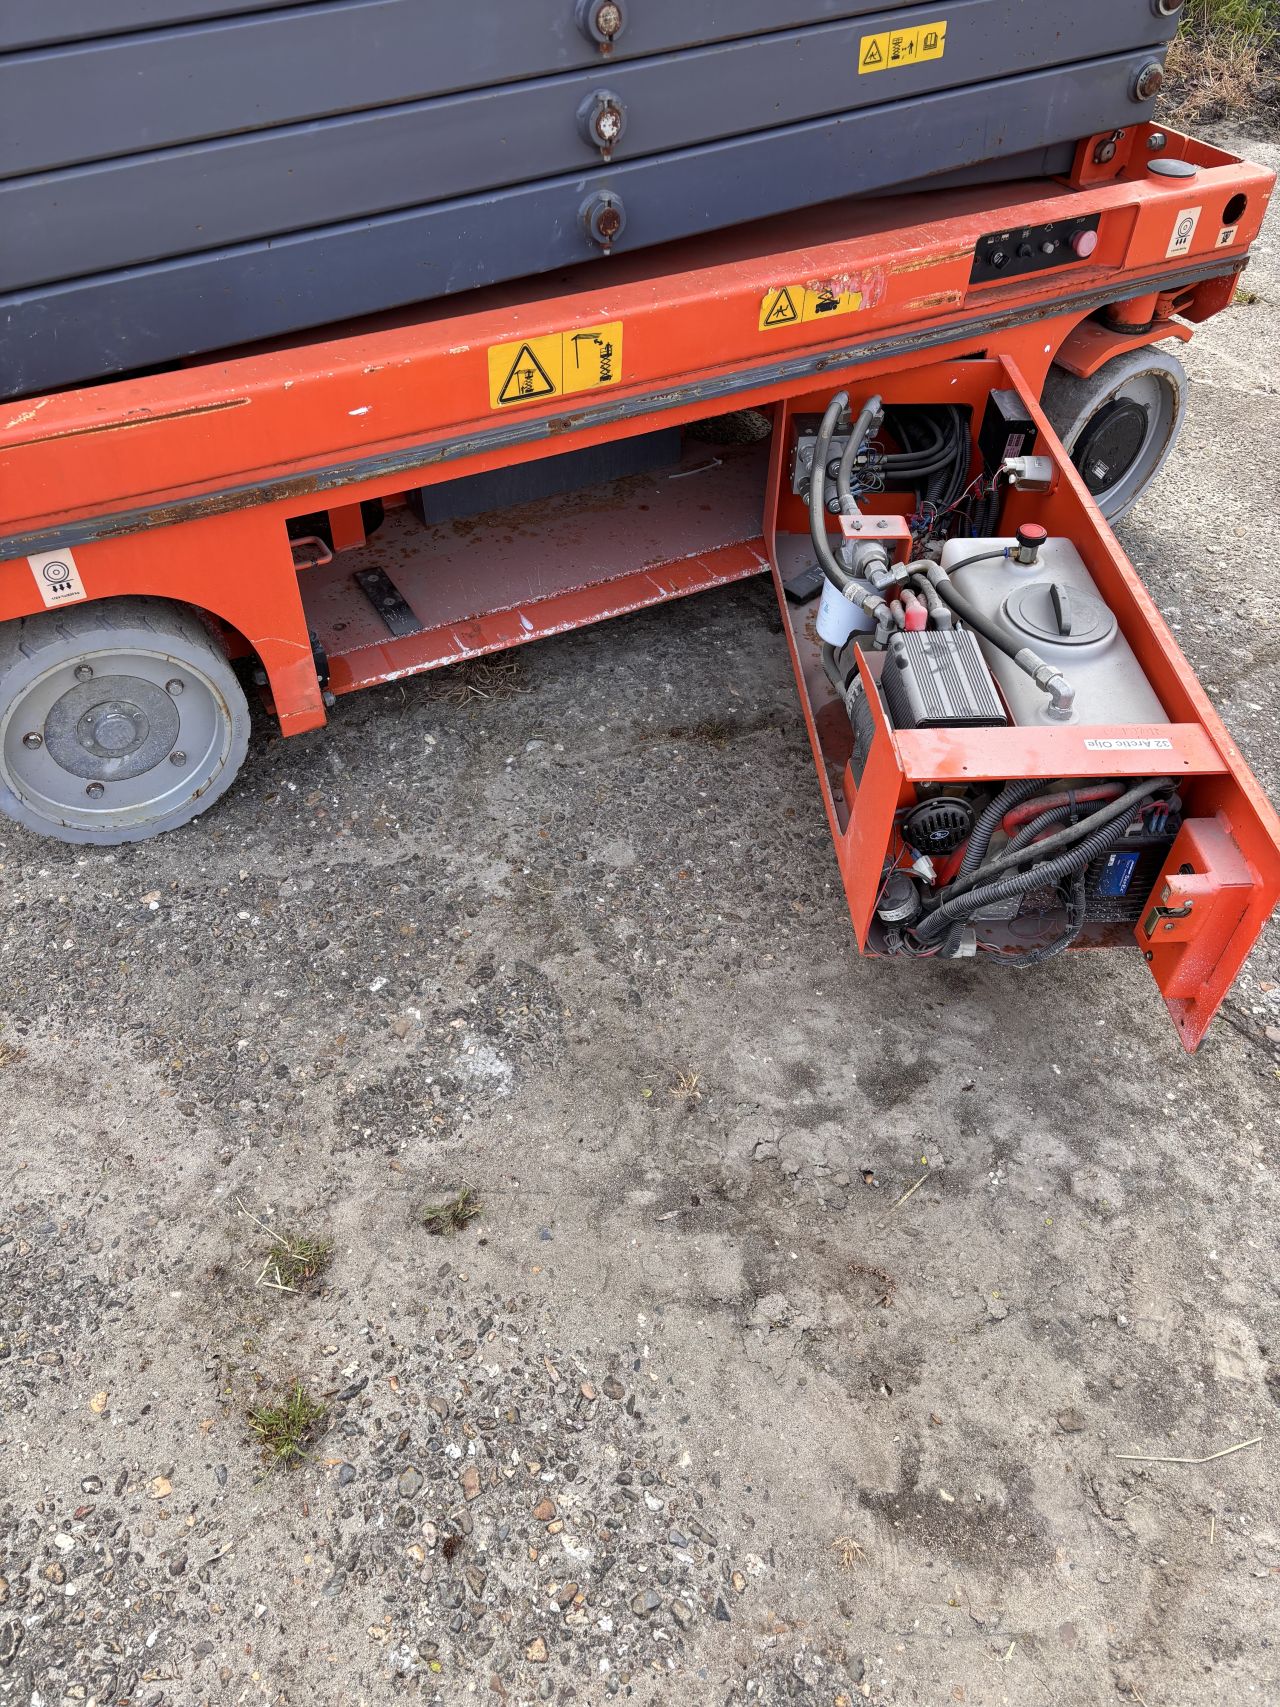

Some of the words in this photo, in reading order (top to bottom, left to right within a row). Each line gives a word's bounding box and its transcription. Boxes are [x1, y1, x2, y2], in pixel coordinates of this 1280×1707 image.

[1087, 739, 1113, 749] Olje
[1115, 740, 1150, 748] Arctic
[1154, 740, 1170, 748] 32
